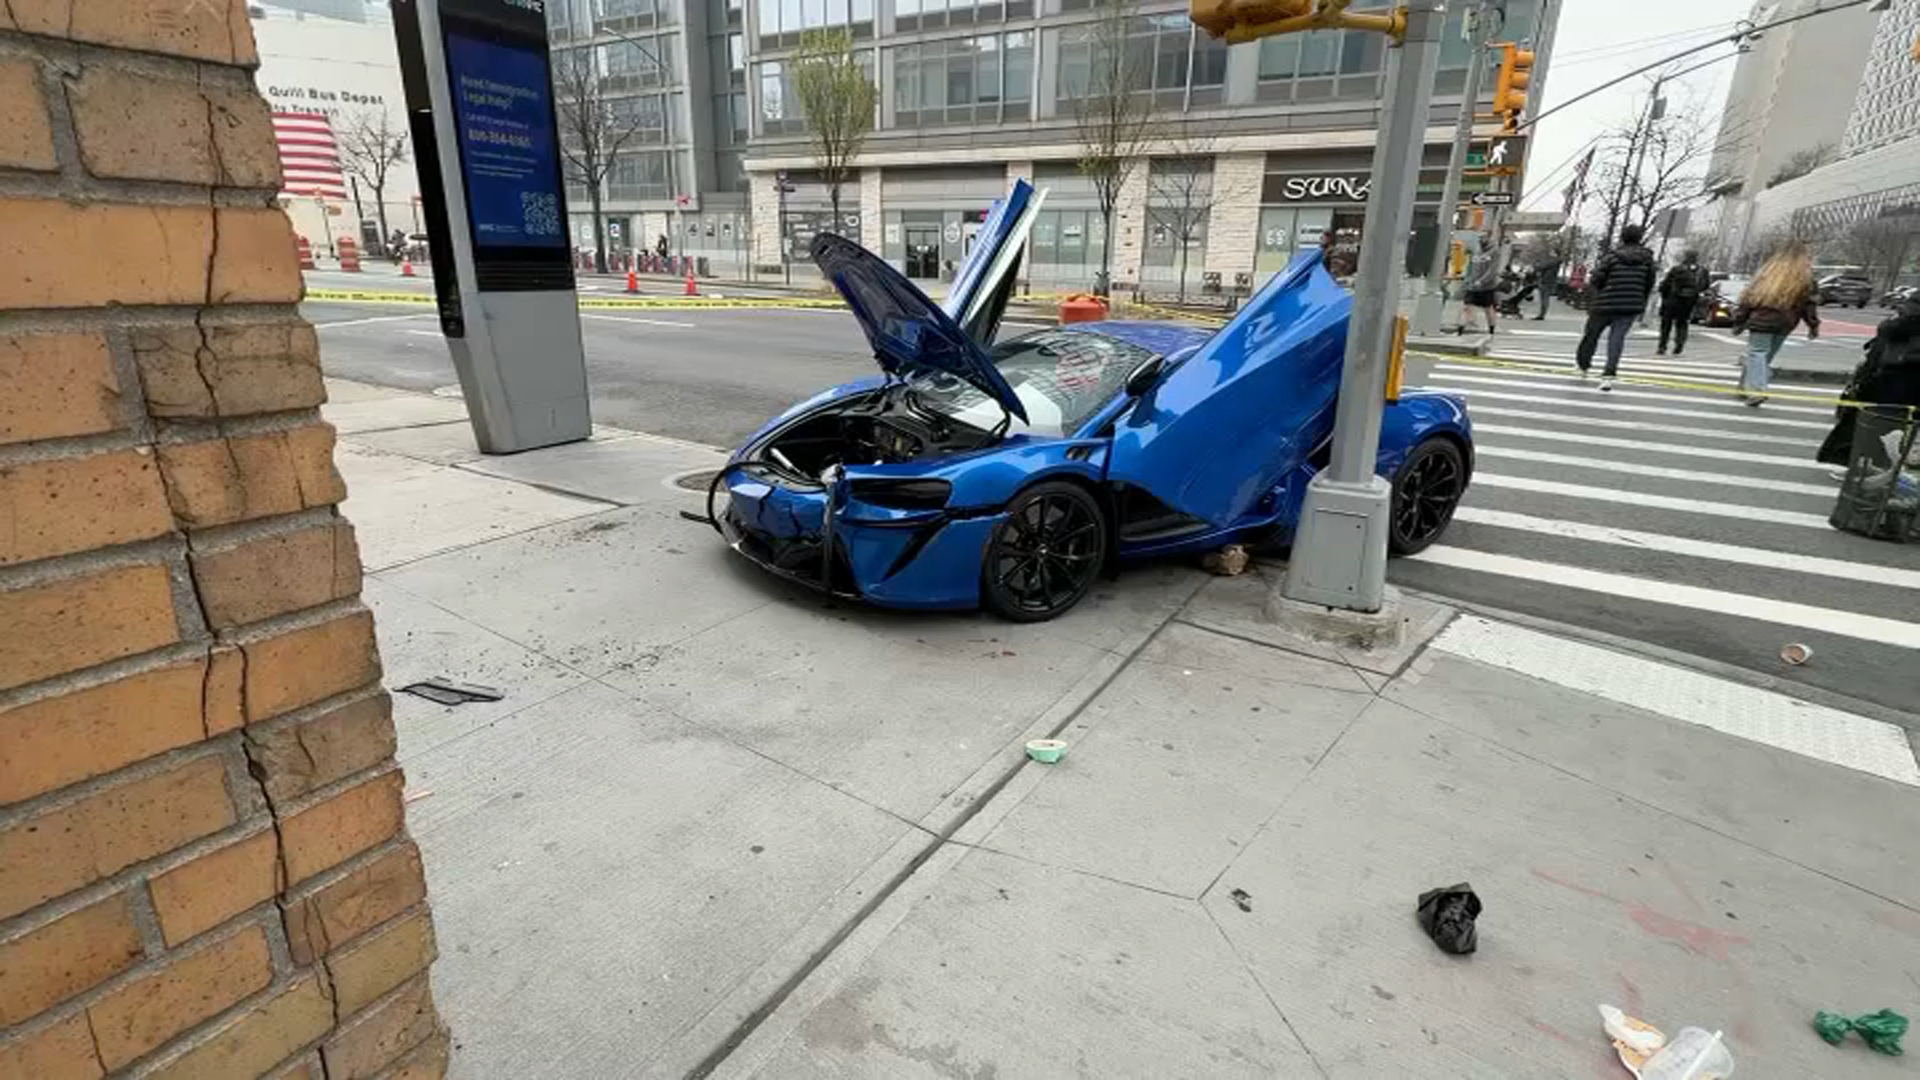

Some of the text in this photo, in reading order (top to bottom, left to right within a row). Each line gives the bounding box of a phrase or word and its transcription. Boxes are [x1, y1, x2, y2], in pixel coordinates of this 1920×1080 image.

[269, 85, 384, 105] Quill Bus Depot
